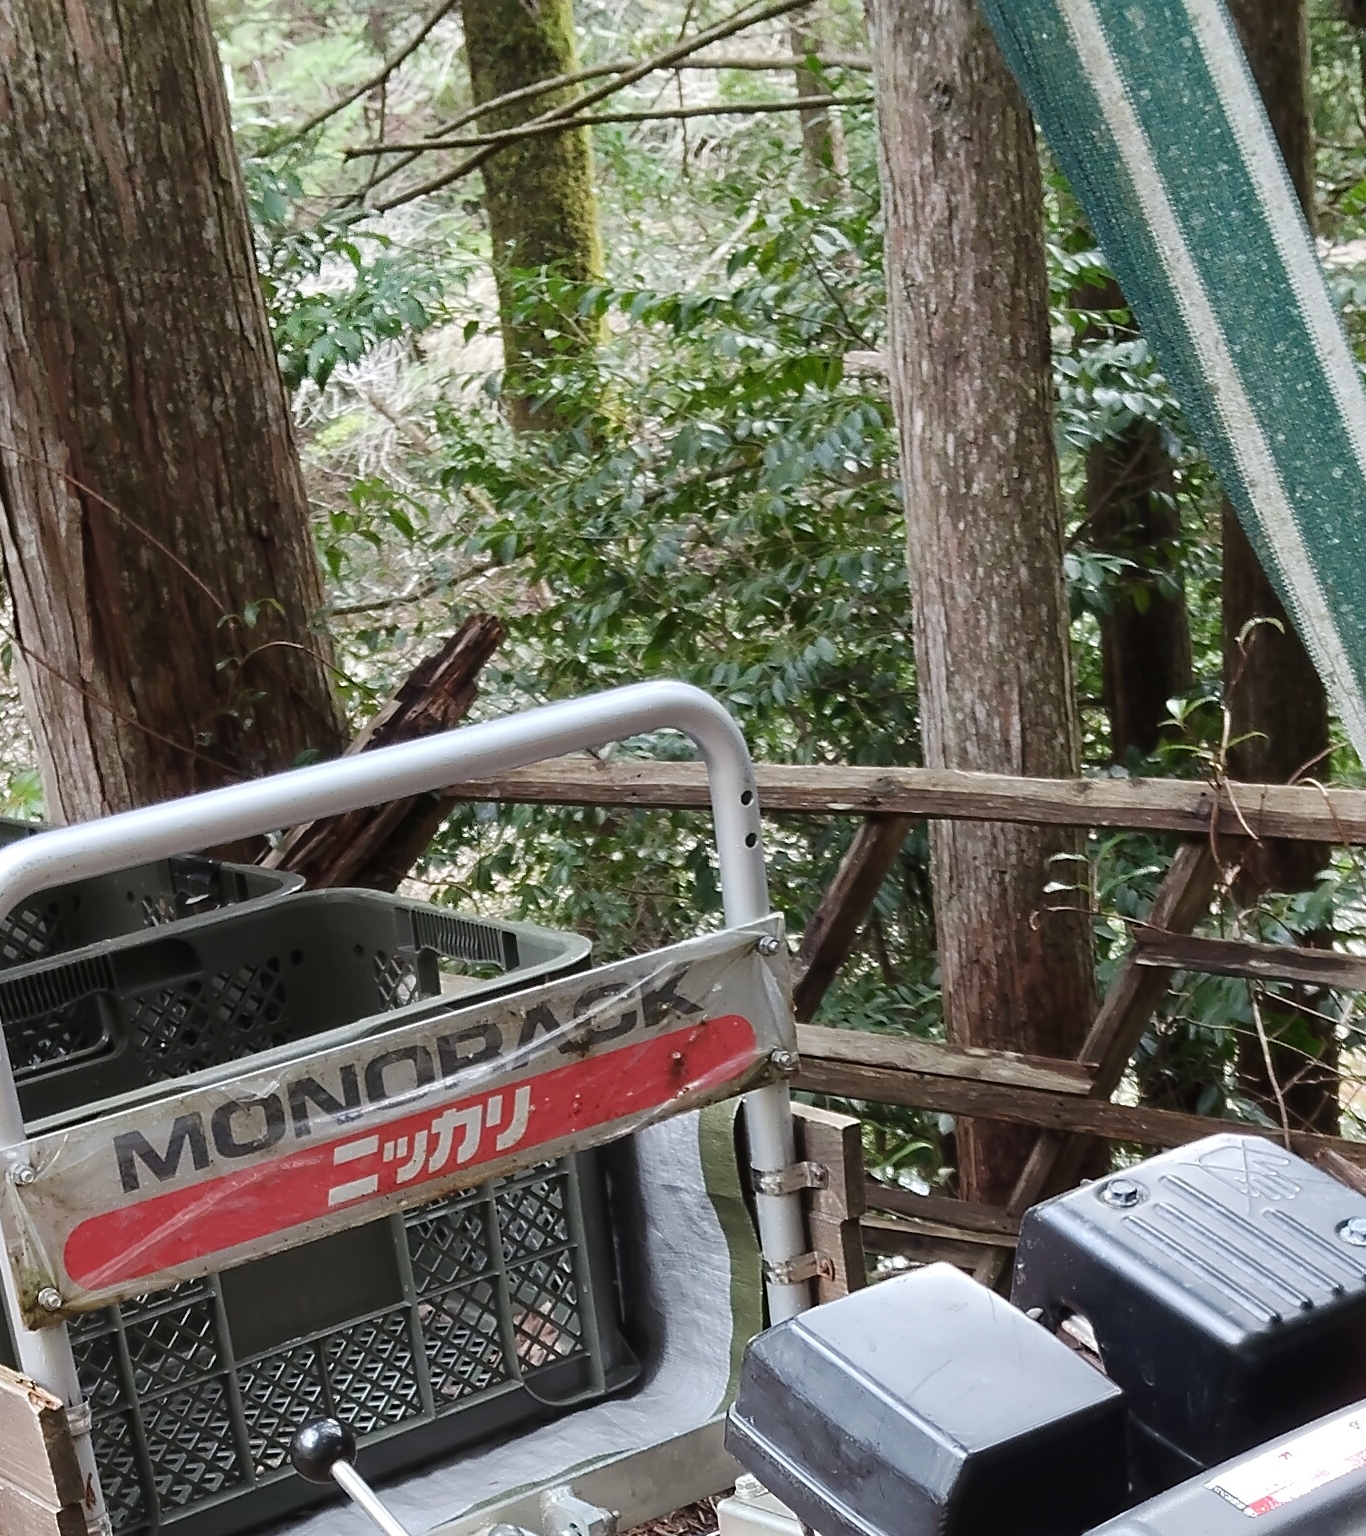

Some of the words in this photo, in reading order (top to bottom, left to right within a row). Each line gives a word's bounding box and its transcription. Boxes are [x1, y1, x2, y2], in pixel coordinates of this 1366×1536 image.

[111, 962, 704, 1193] MONORACK
[328, 1085, 533, 1206] ニッカリ
